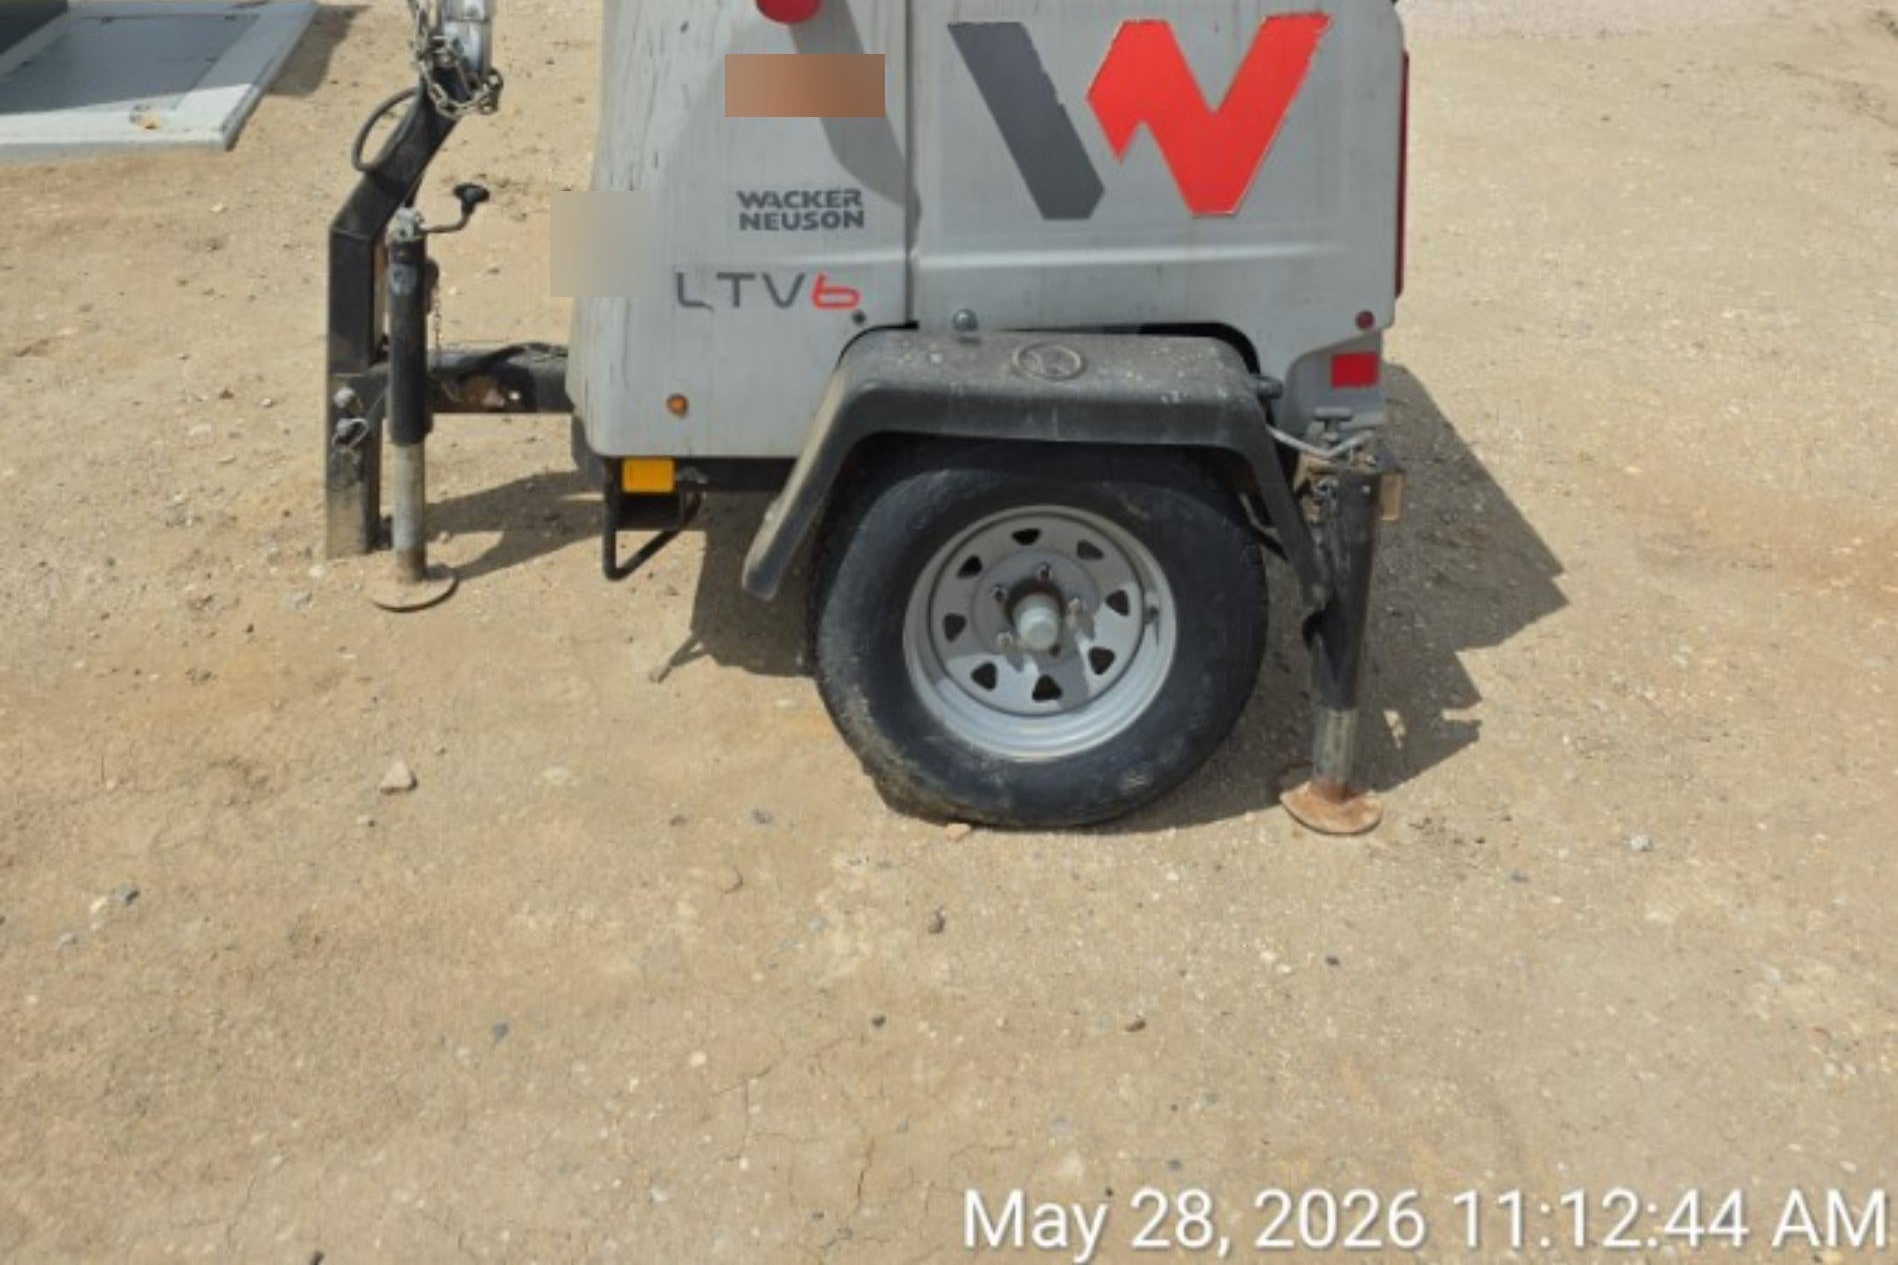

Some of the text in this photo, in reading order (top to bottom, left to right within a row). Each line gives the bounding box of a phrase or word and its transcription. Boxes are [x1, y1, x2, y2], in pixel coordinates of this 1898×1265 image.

[736, 189, 864, 209] WACKER
[738, 210, 865, 231] NEUSON
[675, 270, 861, 311] LTV6
